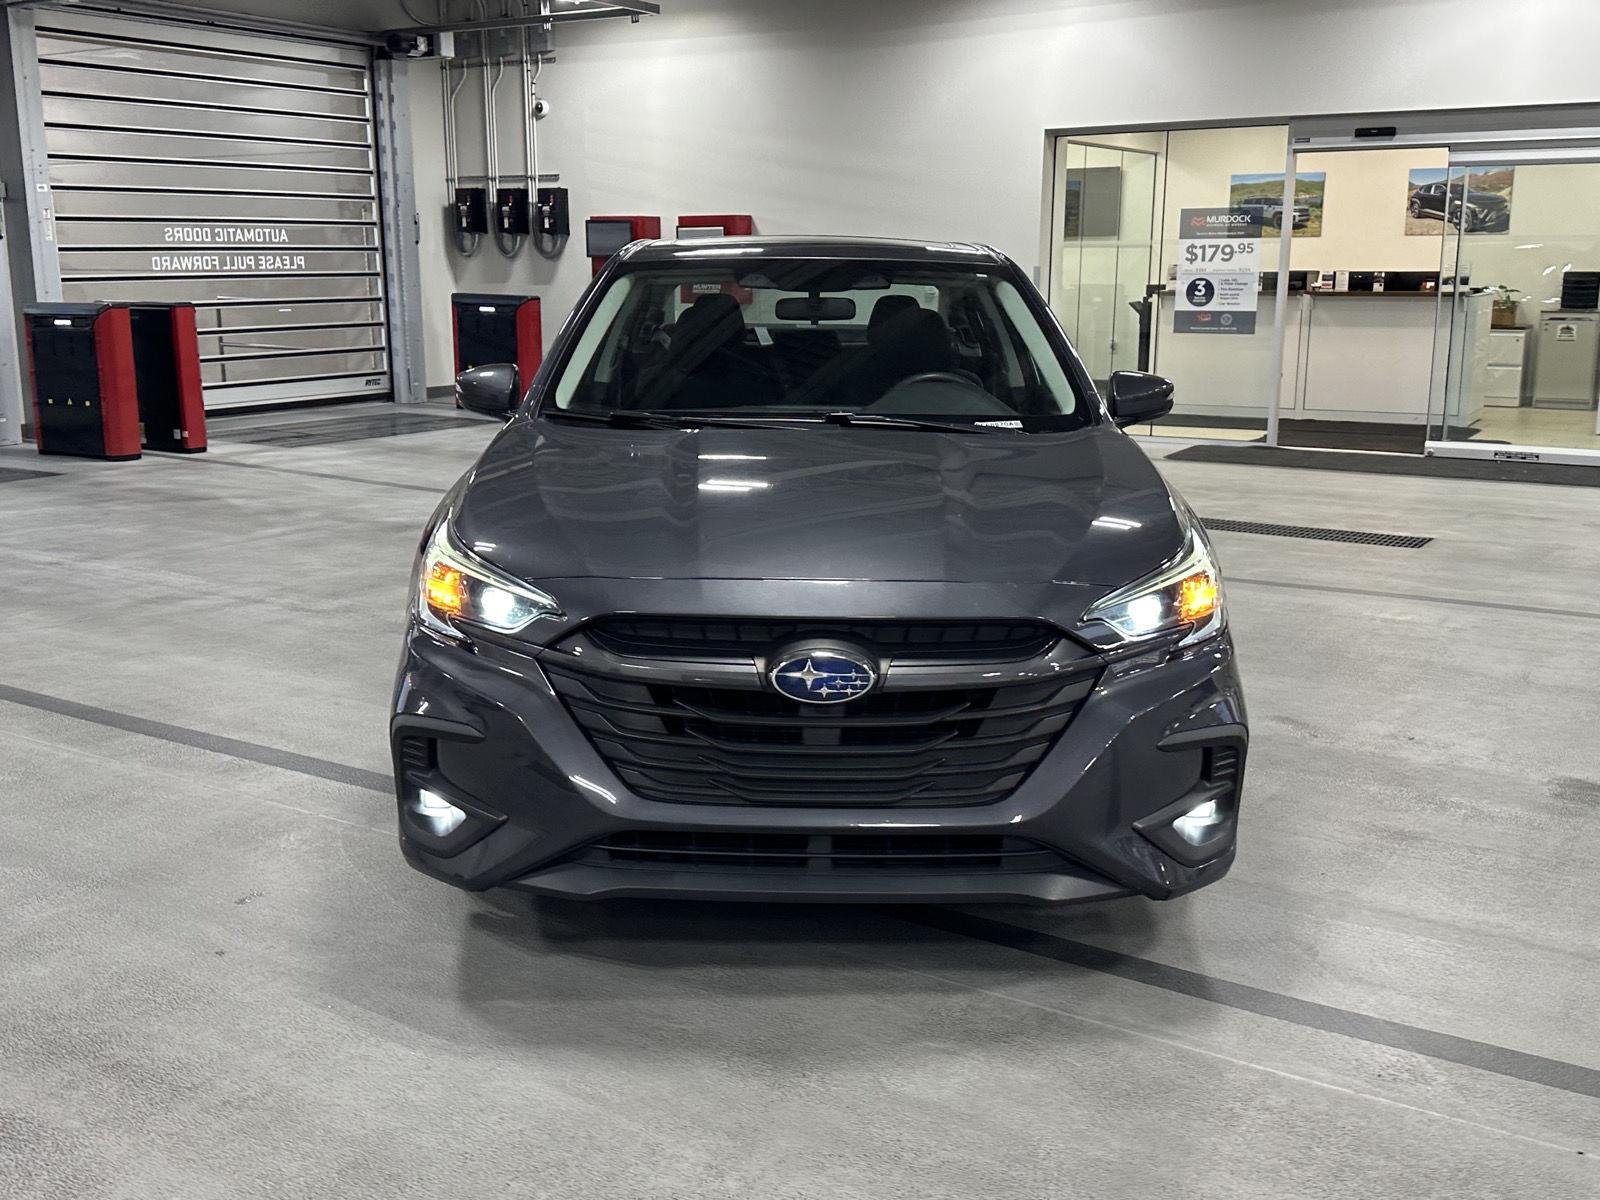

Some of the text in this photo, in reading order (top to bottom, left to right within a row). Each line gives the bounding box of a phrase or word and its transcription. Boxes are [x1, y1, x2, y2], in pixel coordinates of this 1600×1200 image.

[1206, 214, 1252, 223] MURDOCK
[1185, 243, 1254, 264] $179.95
[1194, 280, 1206, 296] 3
